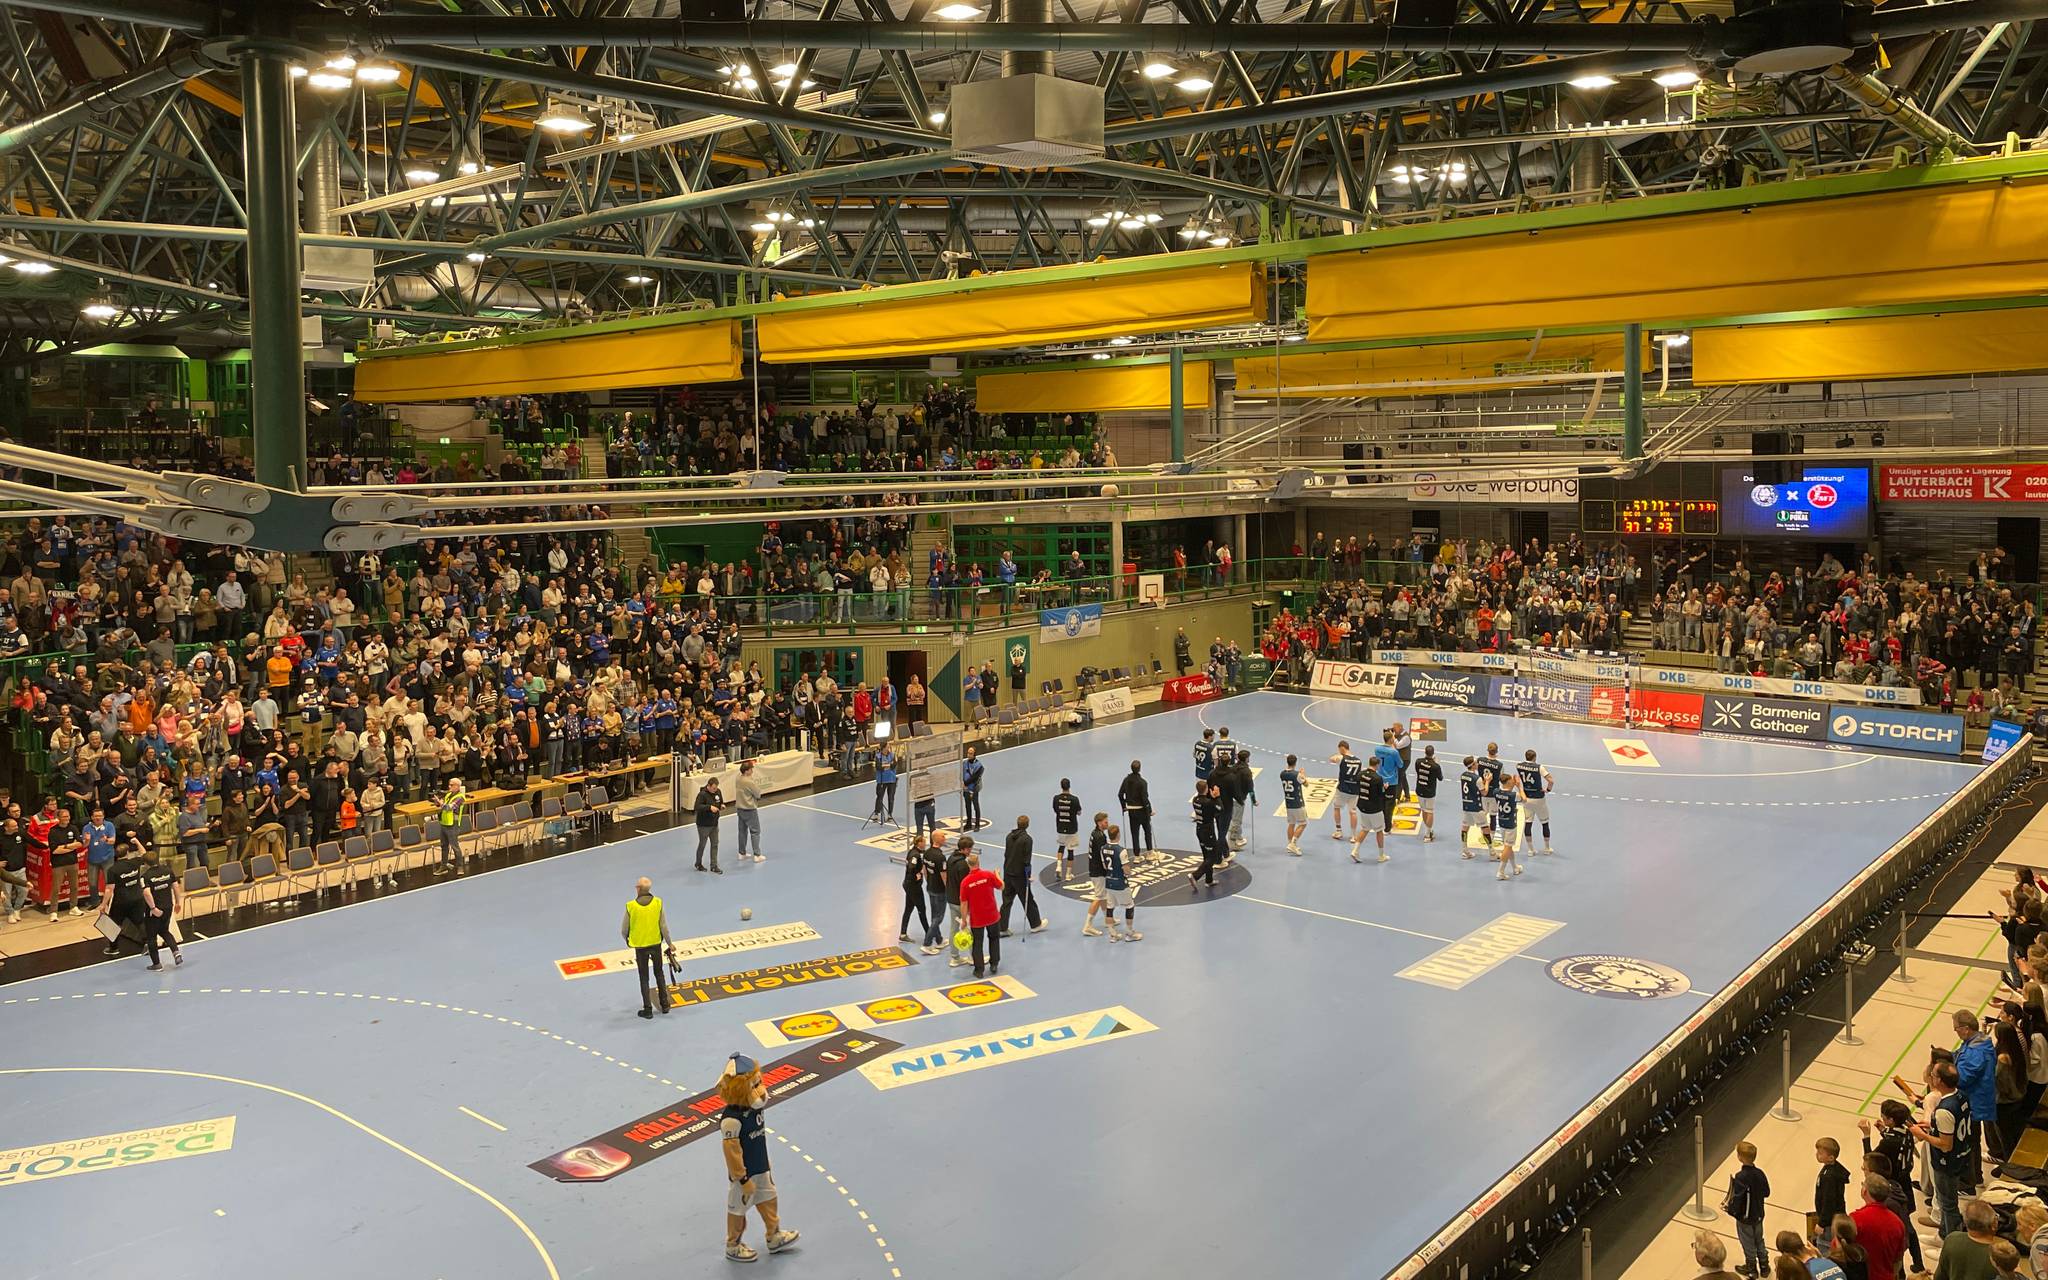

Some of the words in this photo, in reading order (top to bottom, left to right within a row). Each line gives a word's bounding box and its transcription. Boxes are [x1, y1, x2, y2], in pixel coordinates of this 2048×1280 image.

[1930, 467, 1963, 475] Logistik
[1972, 468, 2012, 476] Lagerung
[1889, 477, 1973, 487] LAUTERBACH
[1889, 488, 1898, 498] &
[1904, 488, 1973, 498] KLOPHAUS
[1381, 652, 1403, 661] DKB
[1432, 653, 1453, 663] DKB
[1482, 655, 1505, 665] DKB
[1659, 672, 1686, 683] DKB
[1724, 677, 1752, 689] DKB
[1411, 679, 1476, 694] WILKINSON
[1793, 683, 1823, 695] DKB
[1429, 690, 1454, 698] SWORD
[1865, 688, 1897, 701] DKB
[1621, 706, 1701, 725] Sparkasse
[1751, 704, 1821, 721] Barmenia
[1750, 719, 1810, 734] Gothaer
[1346, 764, 1360, 776] 77
[1520, 771, 1535, 785] 14
[1283, 780, 1294, 792] 25
[1463, 782, 1469, 794] 6
[701, 929, 817, 955] GOTTSCHALL
[1404, 915, 1560, 985] WUPPERTAL
[767, 948, 892, 972] PROTECTING
[724, 955, 911, 995] Bohnen
[670, 989, 711, 1008] IT
[891, 1026, 1078, 1077] DAIKIN
[62, 1121, 217, 1151] Sportstadt
